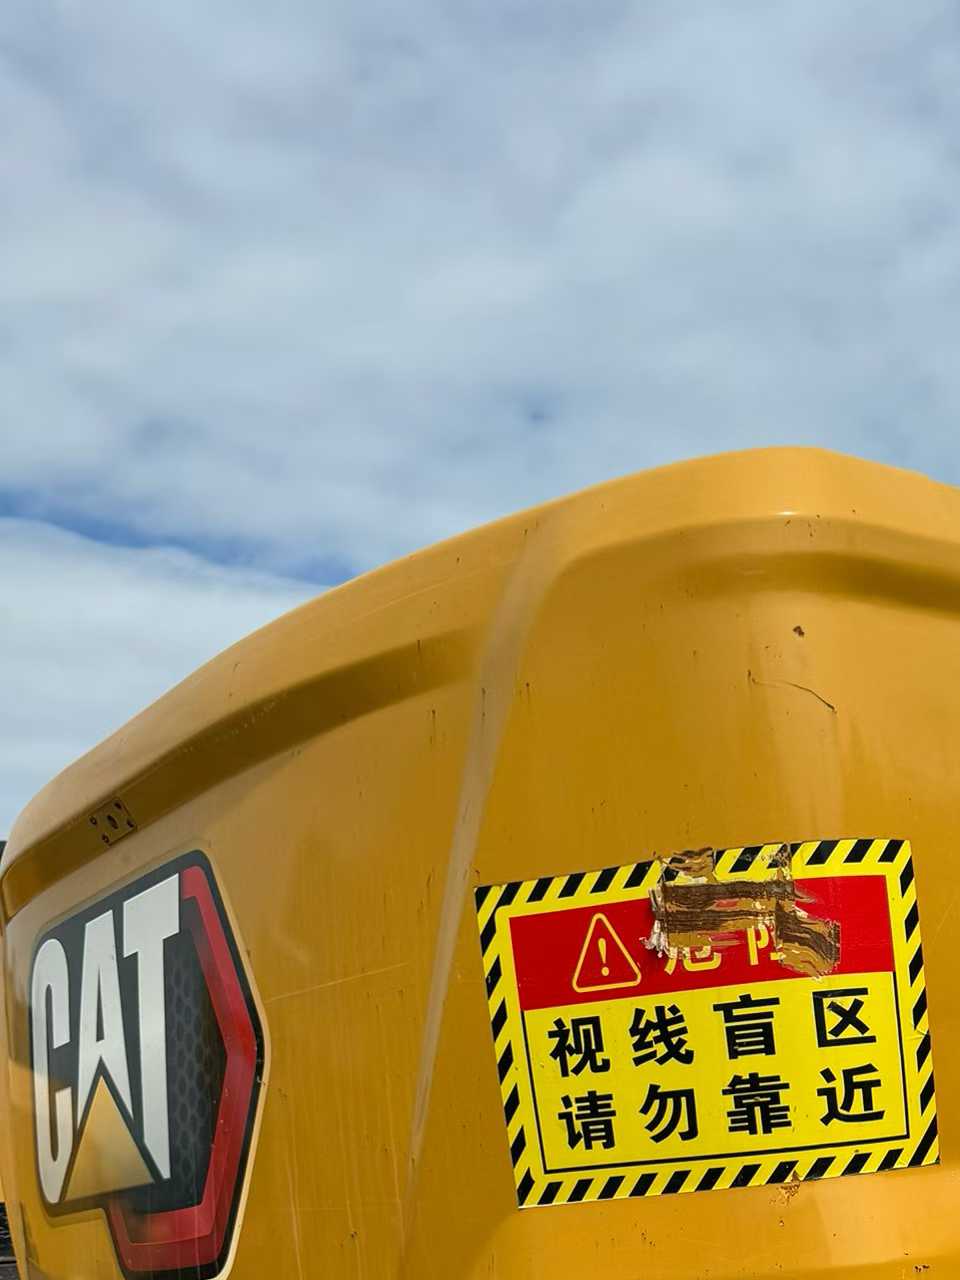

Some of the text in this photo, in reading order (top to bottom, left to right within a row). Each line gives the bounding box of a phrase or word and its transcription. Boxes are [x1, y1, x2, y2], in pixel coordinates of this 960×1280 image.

[31, 873, 179, 1204] CAT
[548, 987, 877, 1077] 视线盲区
[557, 1063, 886, 1151] 请勿靠近
